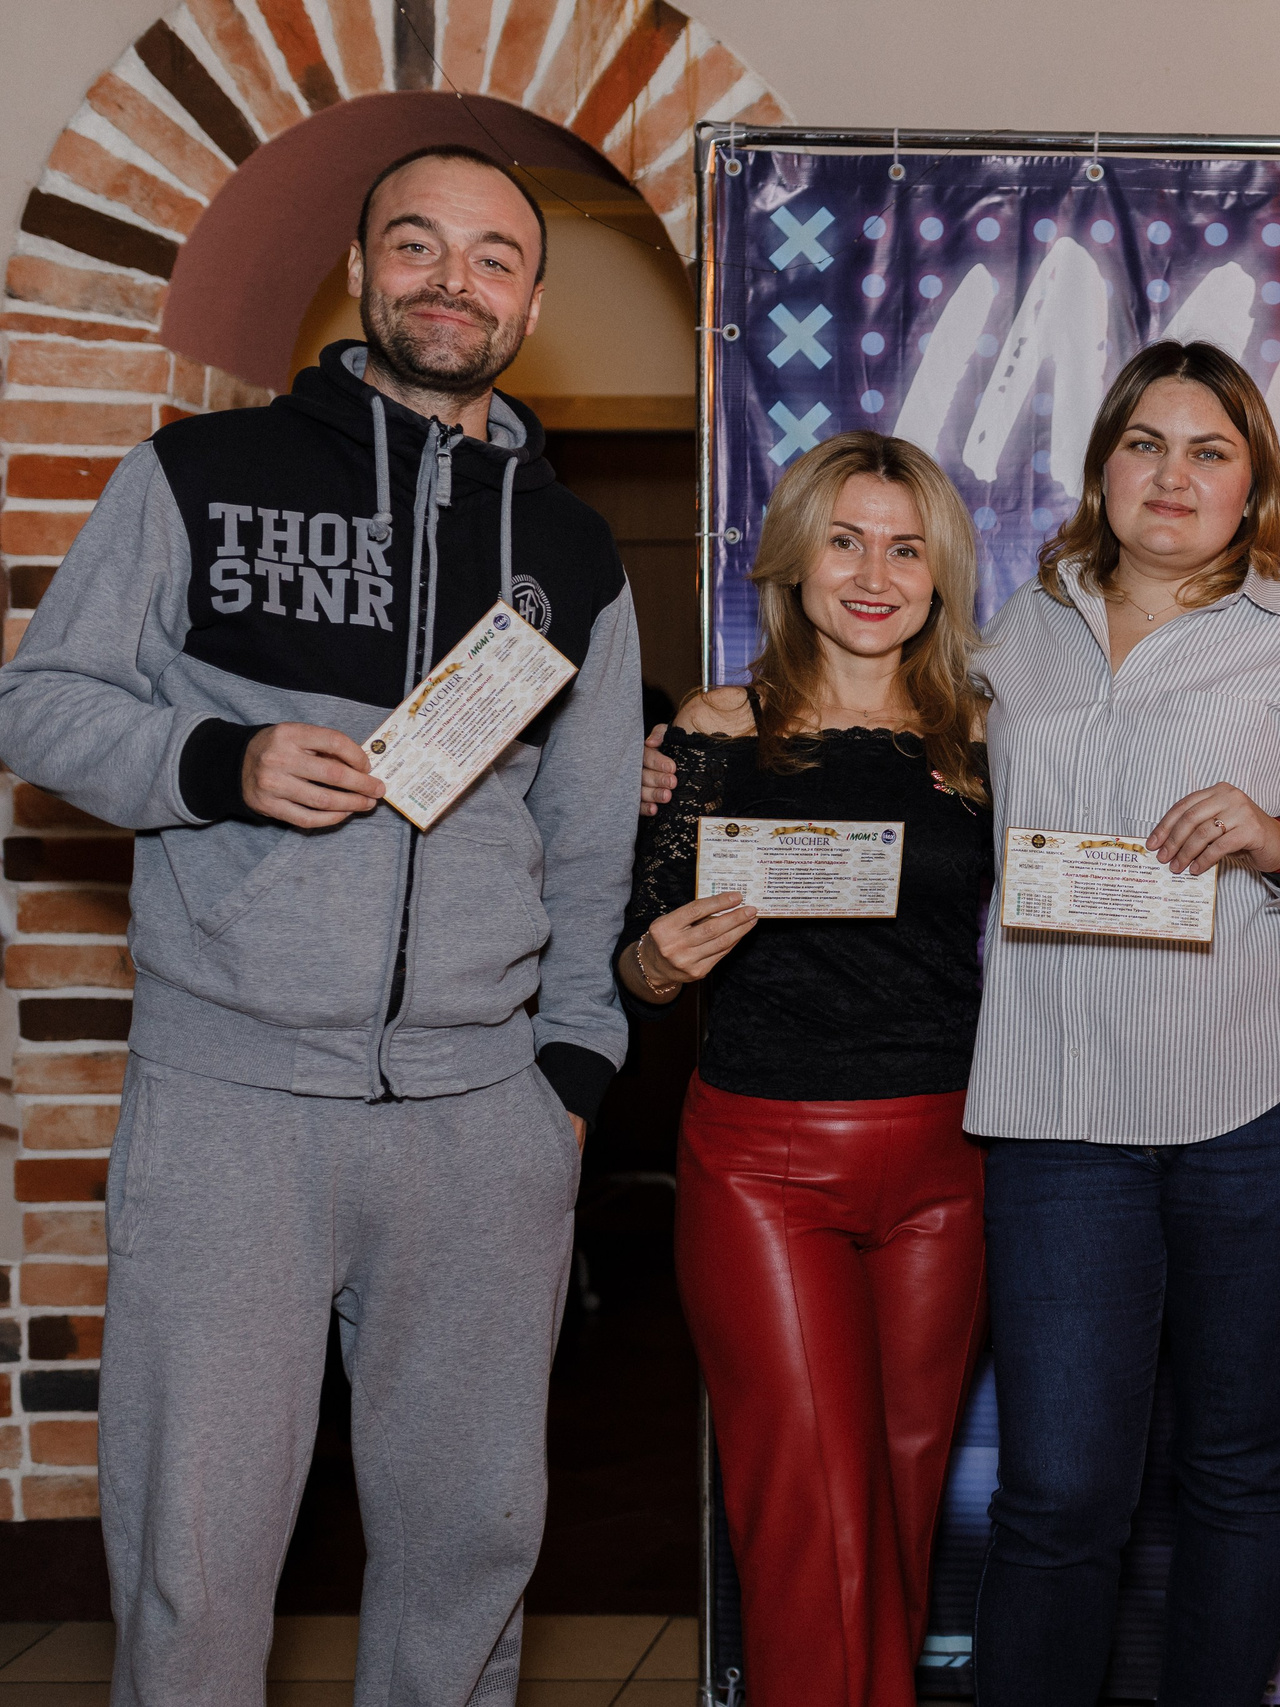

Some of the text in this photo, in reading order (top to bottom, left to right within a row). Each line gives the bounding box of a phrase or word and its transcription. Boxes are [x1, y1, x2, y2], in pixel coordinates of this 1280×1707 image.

[208, 502, 394, 577] THOR
[209, 558, 394, 633] STNR
[418, 674, 464, 718] VOUCHER
[777, 836, 830, 846] VOUCHER
[1084, 850, 1139, 862] VOUCHER
